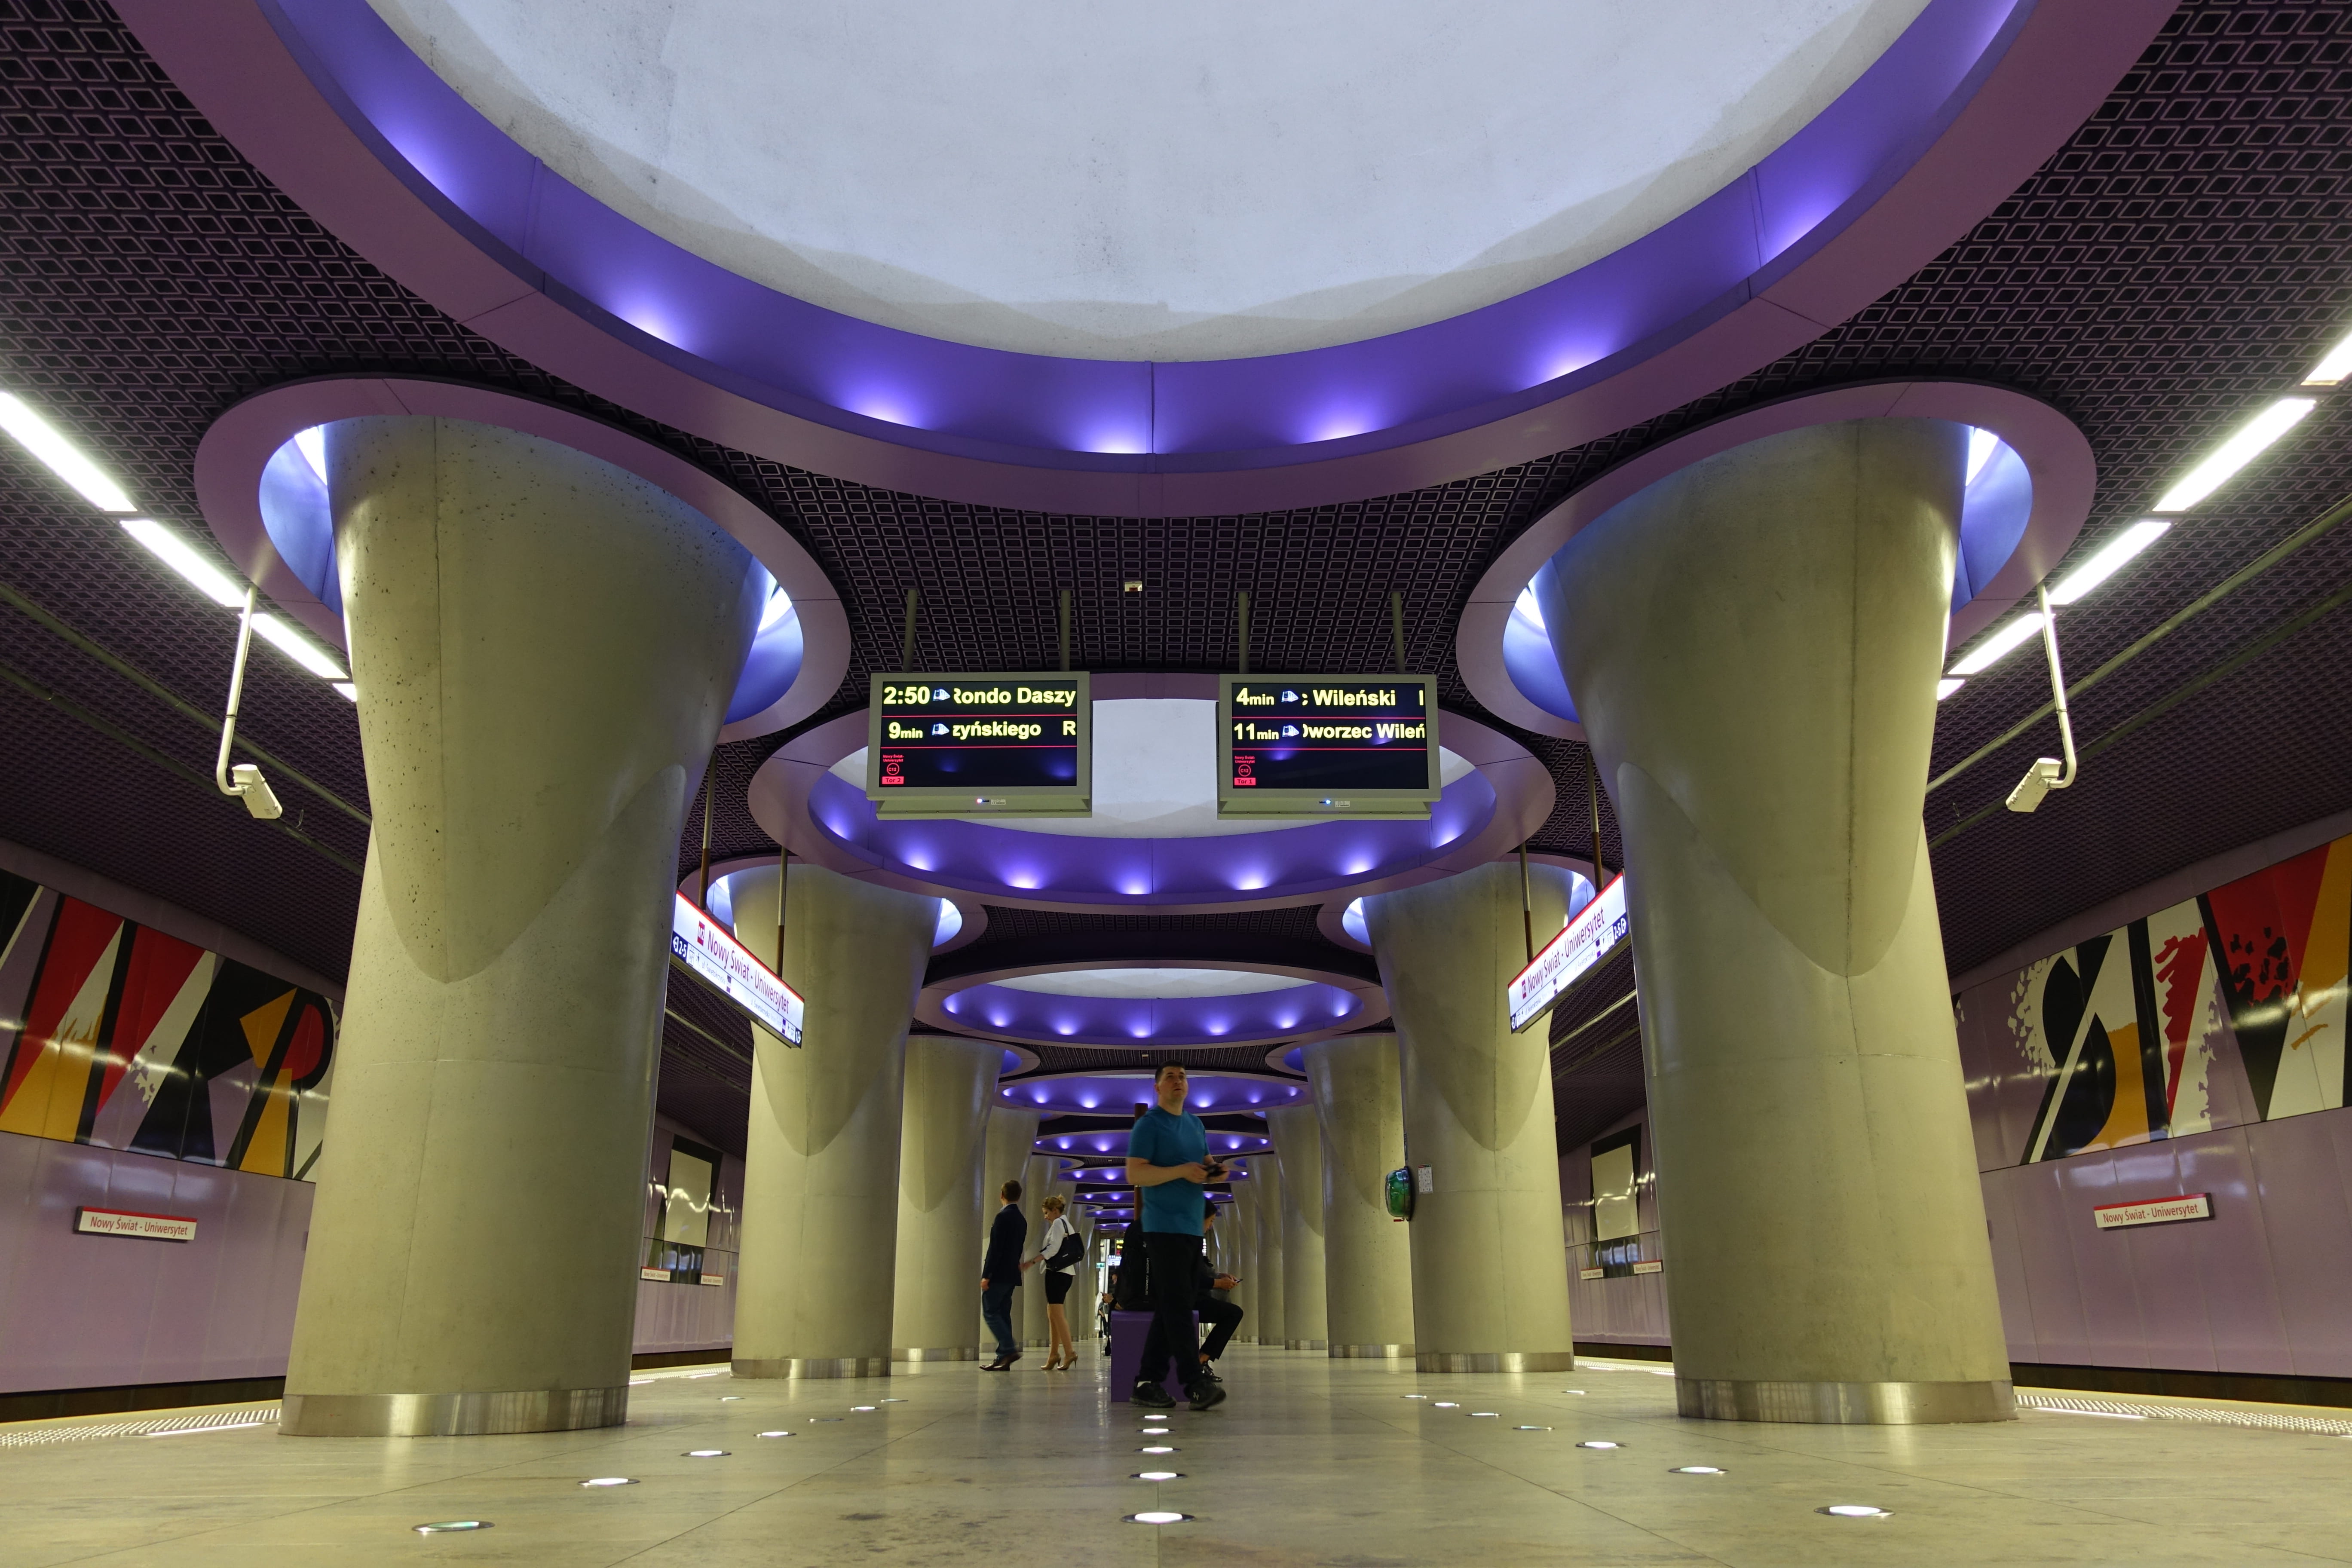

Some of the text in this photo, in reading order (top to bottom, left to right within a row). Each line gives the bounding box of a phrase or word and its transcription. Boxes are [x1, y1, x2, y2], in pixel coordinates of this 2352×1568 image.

[883, 686, 930, 704] 2:50
[1017, 687, 1076, 707] Daszy
[1236, 688, 1275, 705] 4min
[1313, 689, 1396, 706] Wileński
[889, 721, 1076, 740] 9min zyńskiego R
[1376, 723, 1425, 738] Wileń
[678, 940, 687, 958] 2-5
[1528, 967, 1543, 993] Nowy
[1544, 948, 1561, 978] Świat
[1564, 906, 1605, 959] Uniwersytet
[707, 930, 729, 970] Nowy
[730, 946, 750, 982] Świat
[755, 969, 789, 1014] Uniwersytet
[2103, 1213, 2123, 1224] Nowy
[2125, 1208, 2146, 1221] Świat
[2151, 1204, 2199, 1217] Uniwersytet
[90, 1216, 114, 1231] Nowy
[116, 1217, 138, 1231] Świat
[144, 1222, 188, 1237] Uniwersytet
